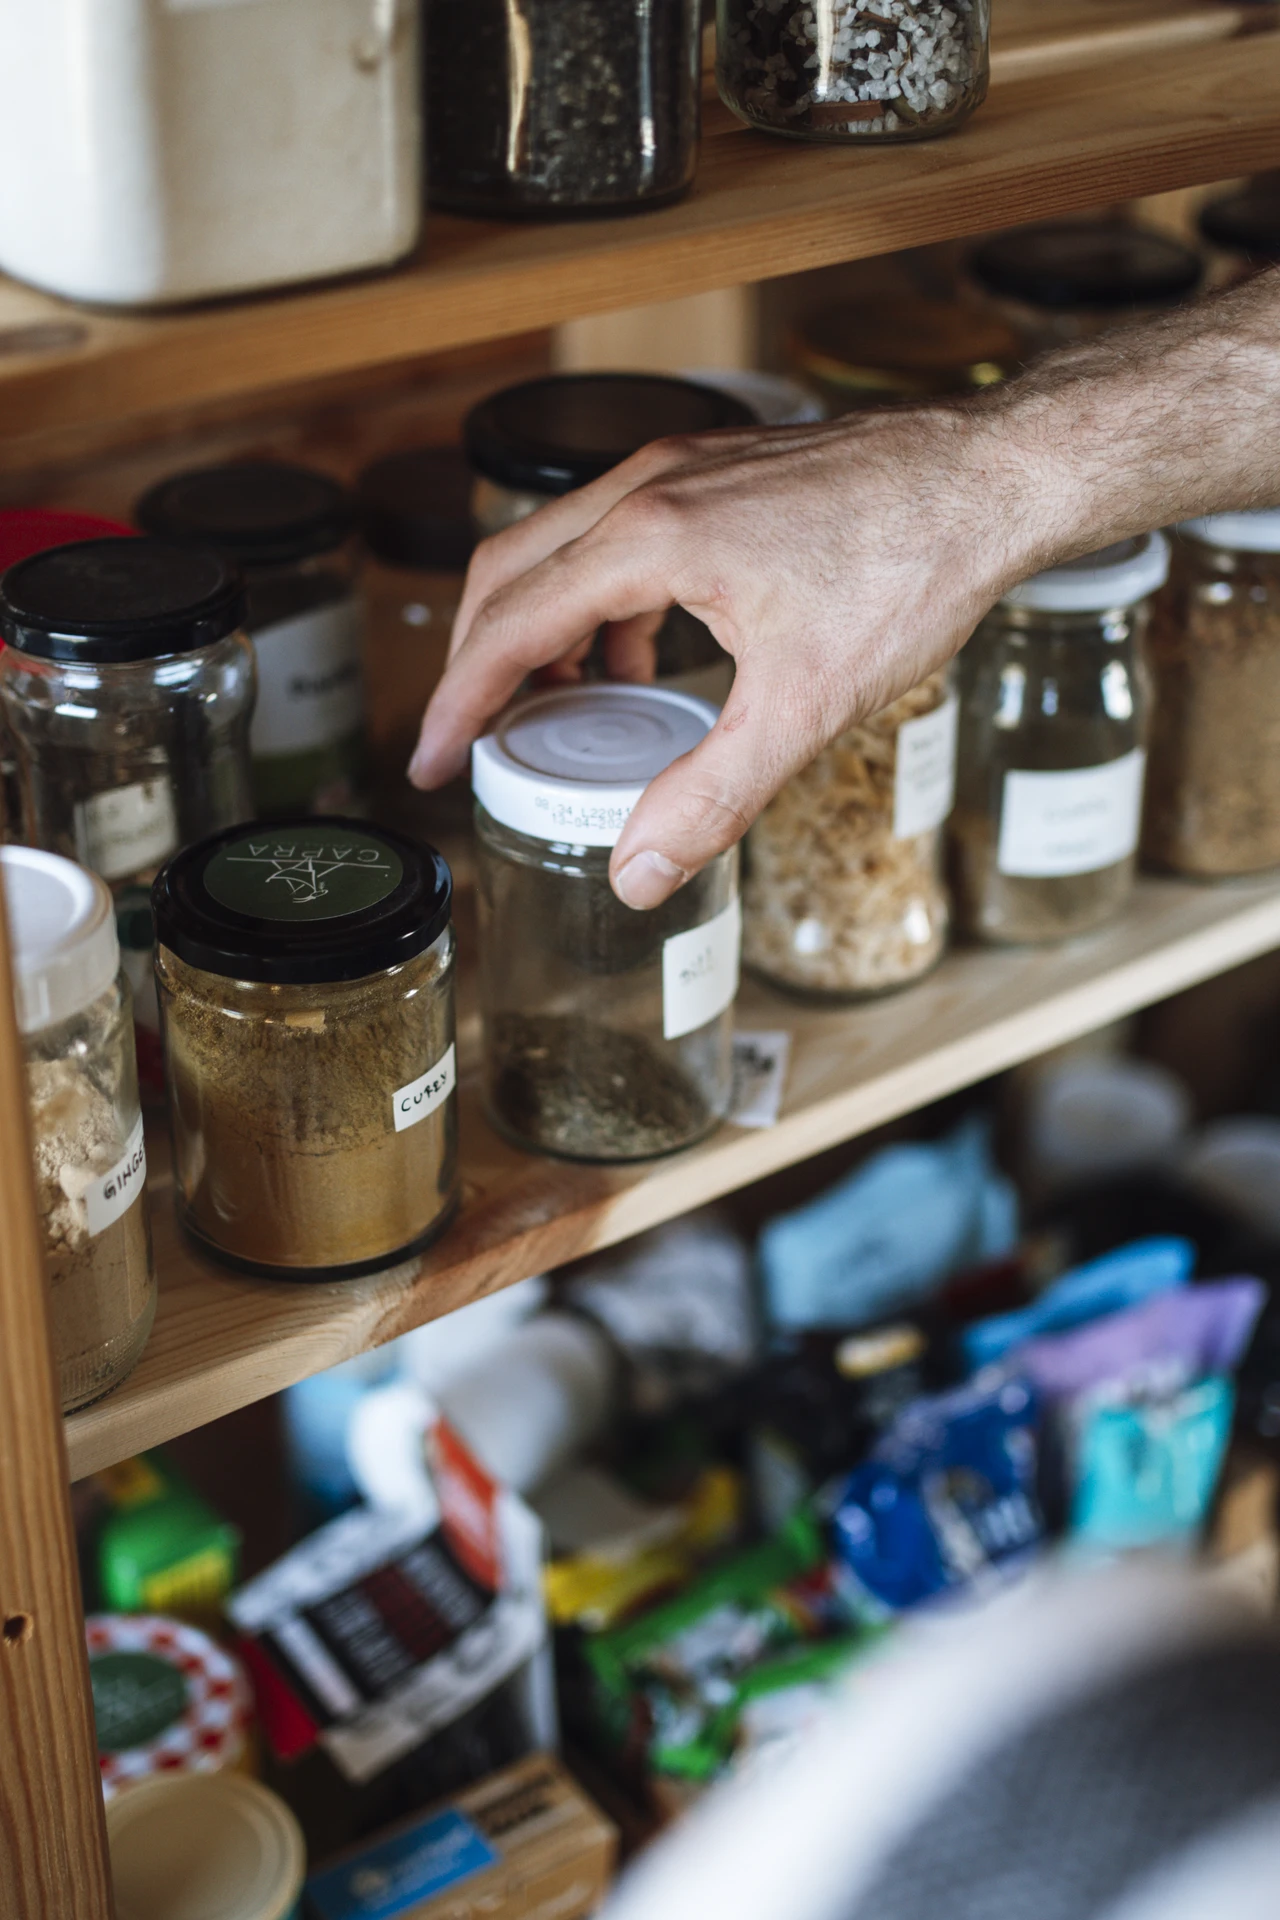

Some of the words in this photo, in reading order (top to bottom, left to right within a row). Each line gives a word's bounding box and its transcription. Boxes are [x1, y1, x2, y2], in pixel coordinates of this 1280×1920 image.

[552, 812, 627, 829] 13-04-202
[249, 843, 379, 862] CAPRA
[401, 1071, 447, 1112] CURRY
[103, 1137, 144, 1200] GINGE
